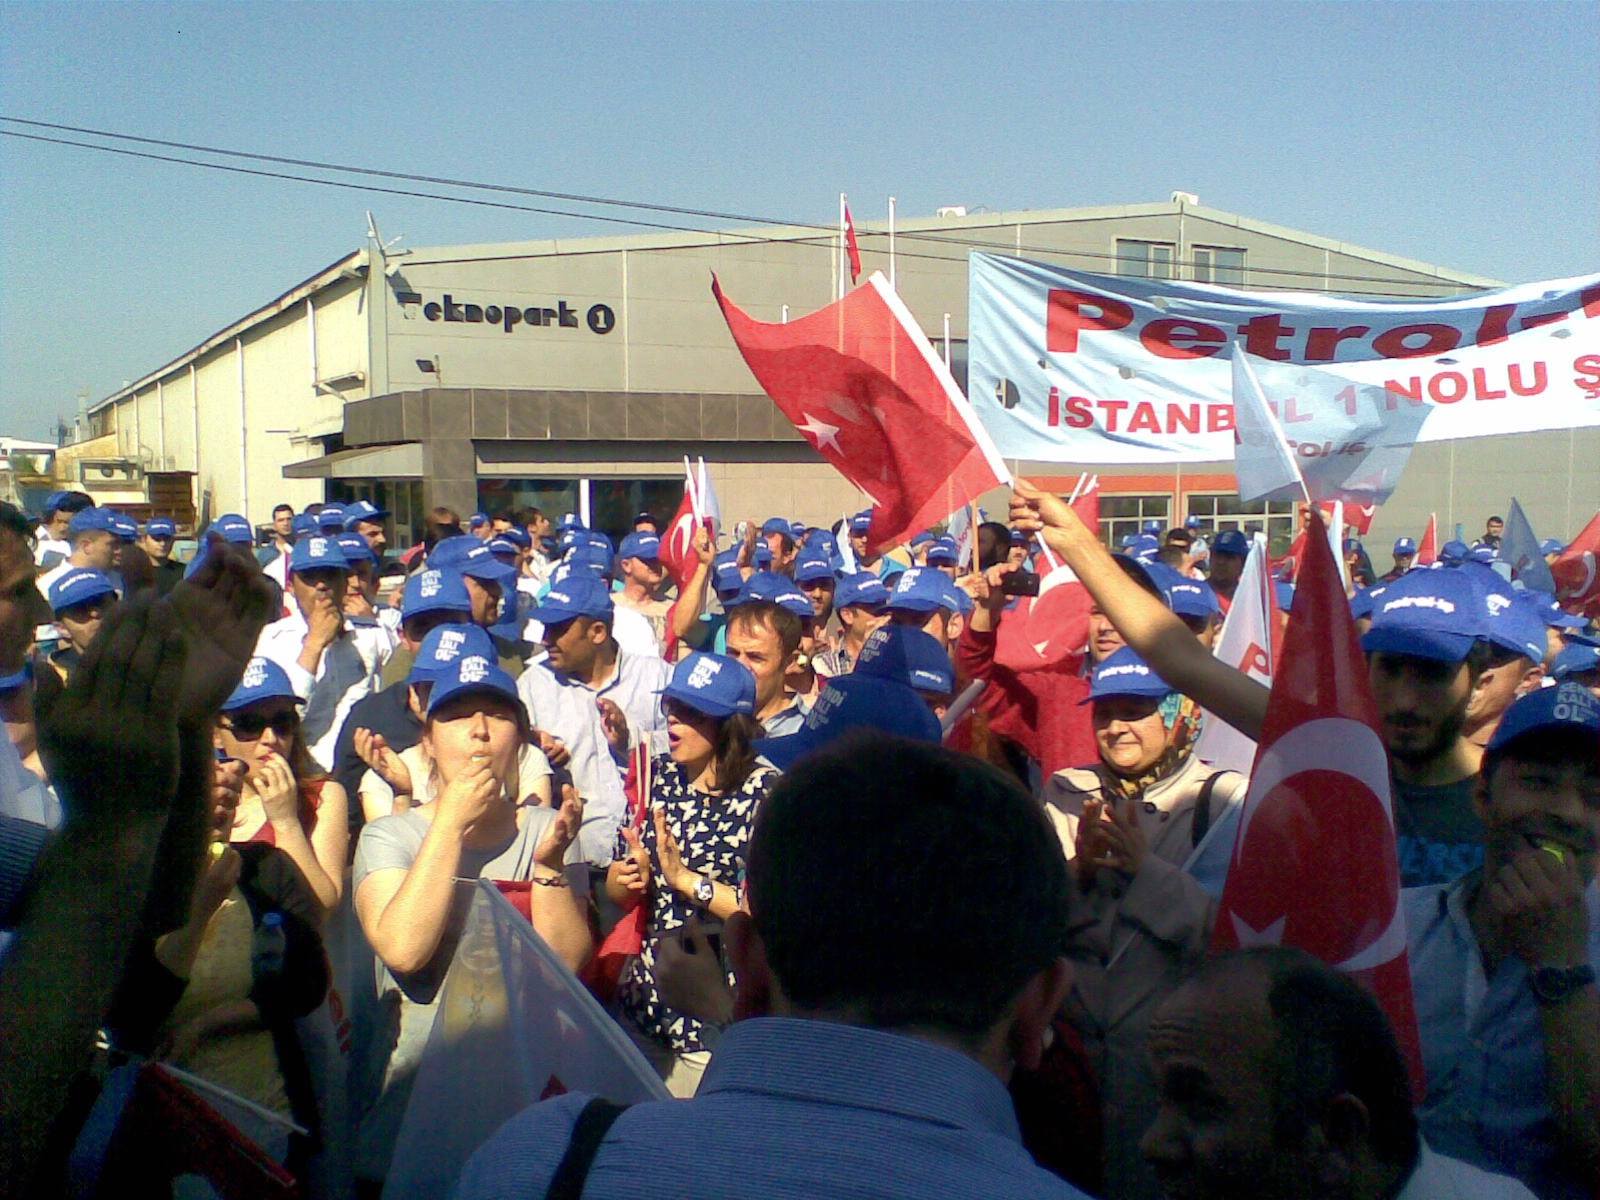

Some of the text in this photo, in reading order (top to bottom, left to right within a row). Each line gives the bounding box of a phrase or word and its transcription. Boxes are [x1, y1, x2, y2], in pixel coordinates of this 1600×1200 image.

[1048, 386, 1313, 434] İSTANBL
[1335, 385, 1358, 416] 1
[1384, 361, 1548, 411] NOLU
